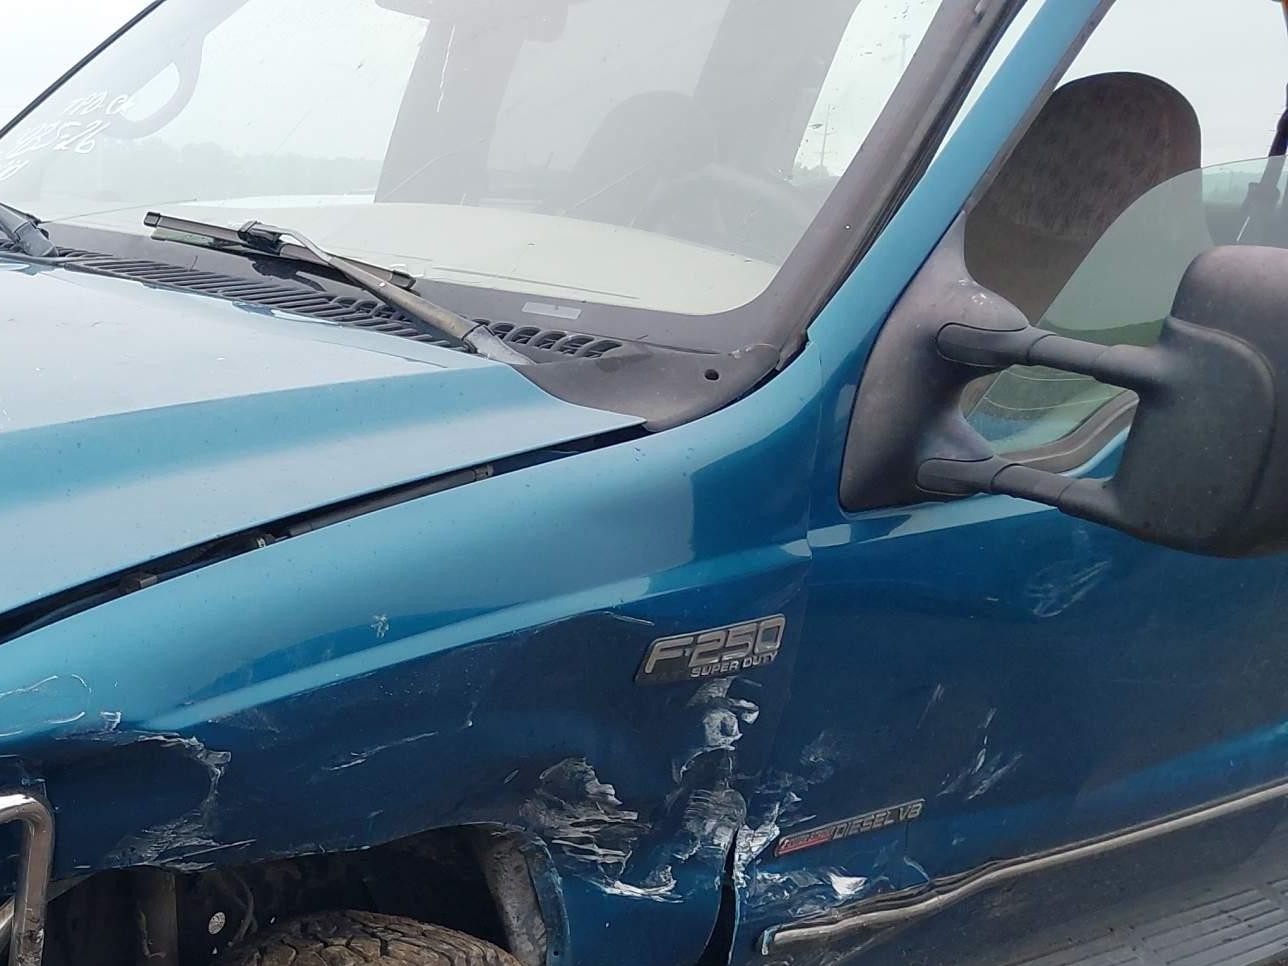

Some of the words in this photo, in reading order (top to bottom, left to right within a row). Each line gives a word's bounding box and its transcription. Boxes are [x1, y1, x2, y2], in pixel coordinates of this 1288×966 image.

[690, 659, 739, 678] SUPER
[742, 650, 779, 668] DUTY
[832, 810, 895, 841] DIESEL
[898, 802, 923, 821] V8
